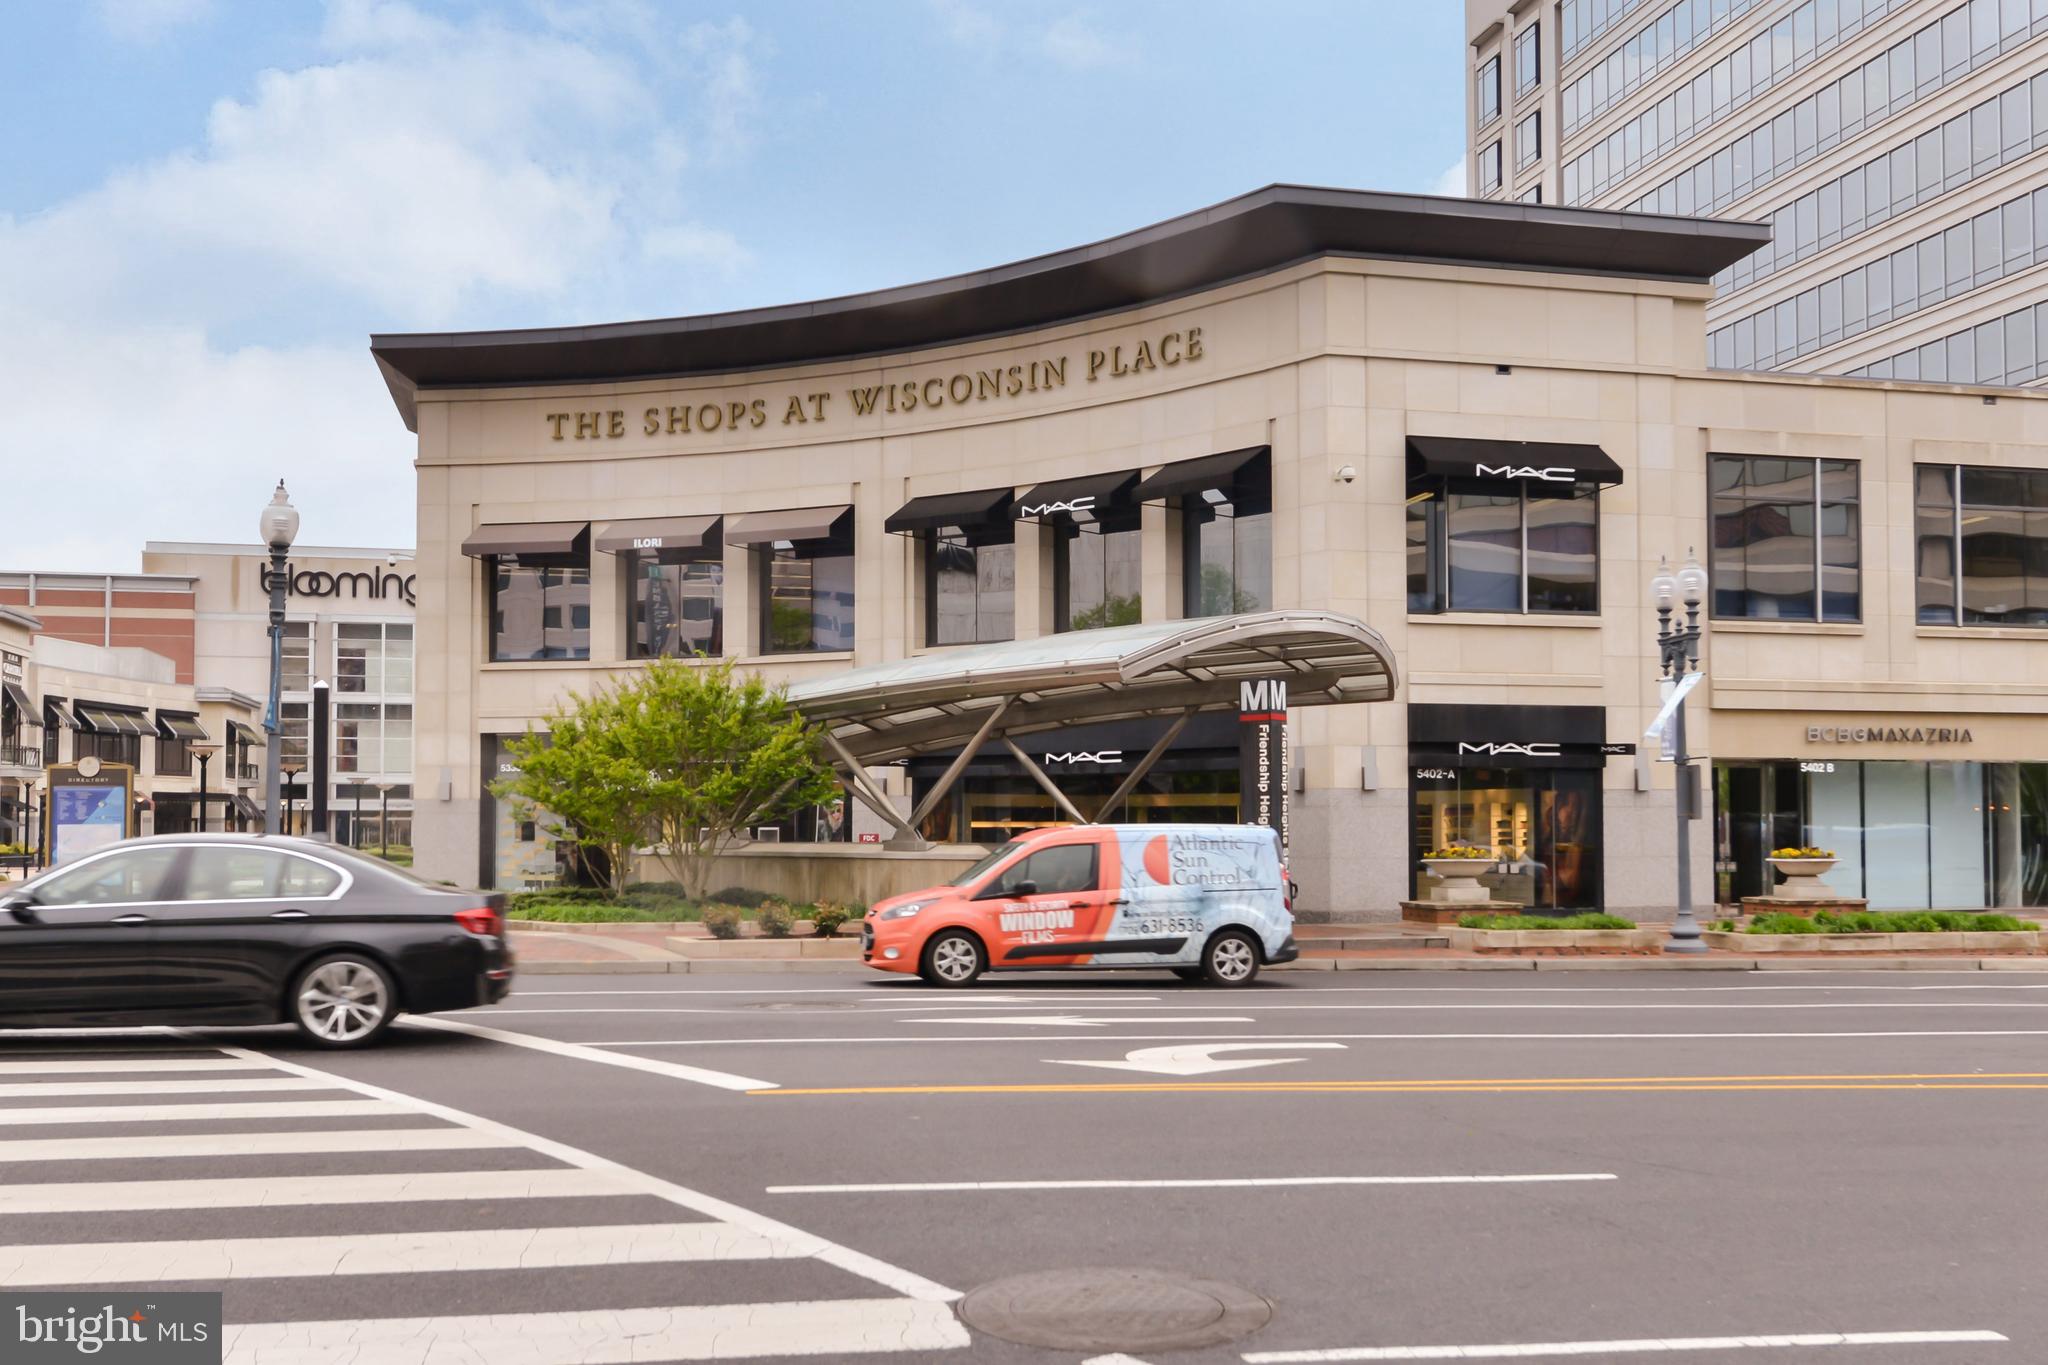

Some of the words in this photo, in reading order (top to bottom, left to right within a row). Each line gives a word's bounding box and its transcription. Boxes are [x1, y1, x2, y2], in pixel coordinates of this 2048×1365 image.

[547, 410, 625, 440] THE
[643, 399, 766, 436] SHOPS
[781, 391, 831, 425] AT
[847, 355, 1067, 417] WISCONSIN
[1085, 326, 1204, 383] PLACE
[633, 537, 663, 549] ILORI
[1240, 680, 1269, 712] M
[1257, 724, 1271, 794] Friendship
[1416, 768, 1456, 779] 5402-A
[1800, 763, 1825, 773] 5402
[1826, 763, 1835, 773] B
[1170, 834, 1244, 850] Atlantic
[1172, 851, 1208, 868] Sun
[1172, 868, 1242, 886] Control
[1000, 910, 1074, 932] WINDOW
[1021, 930, 1056, 944] FILMS
